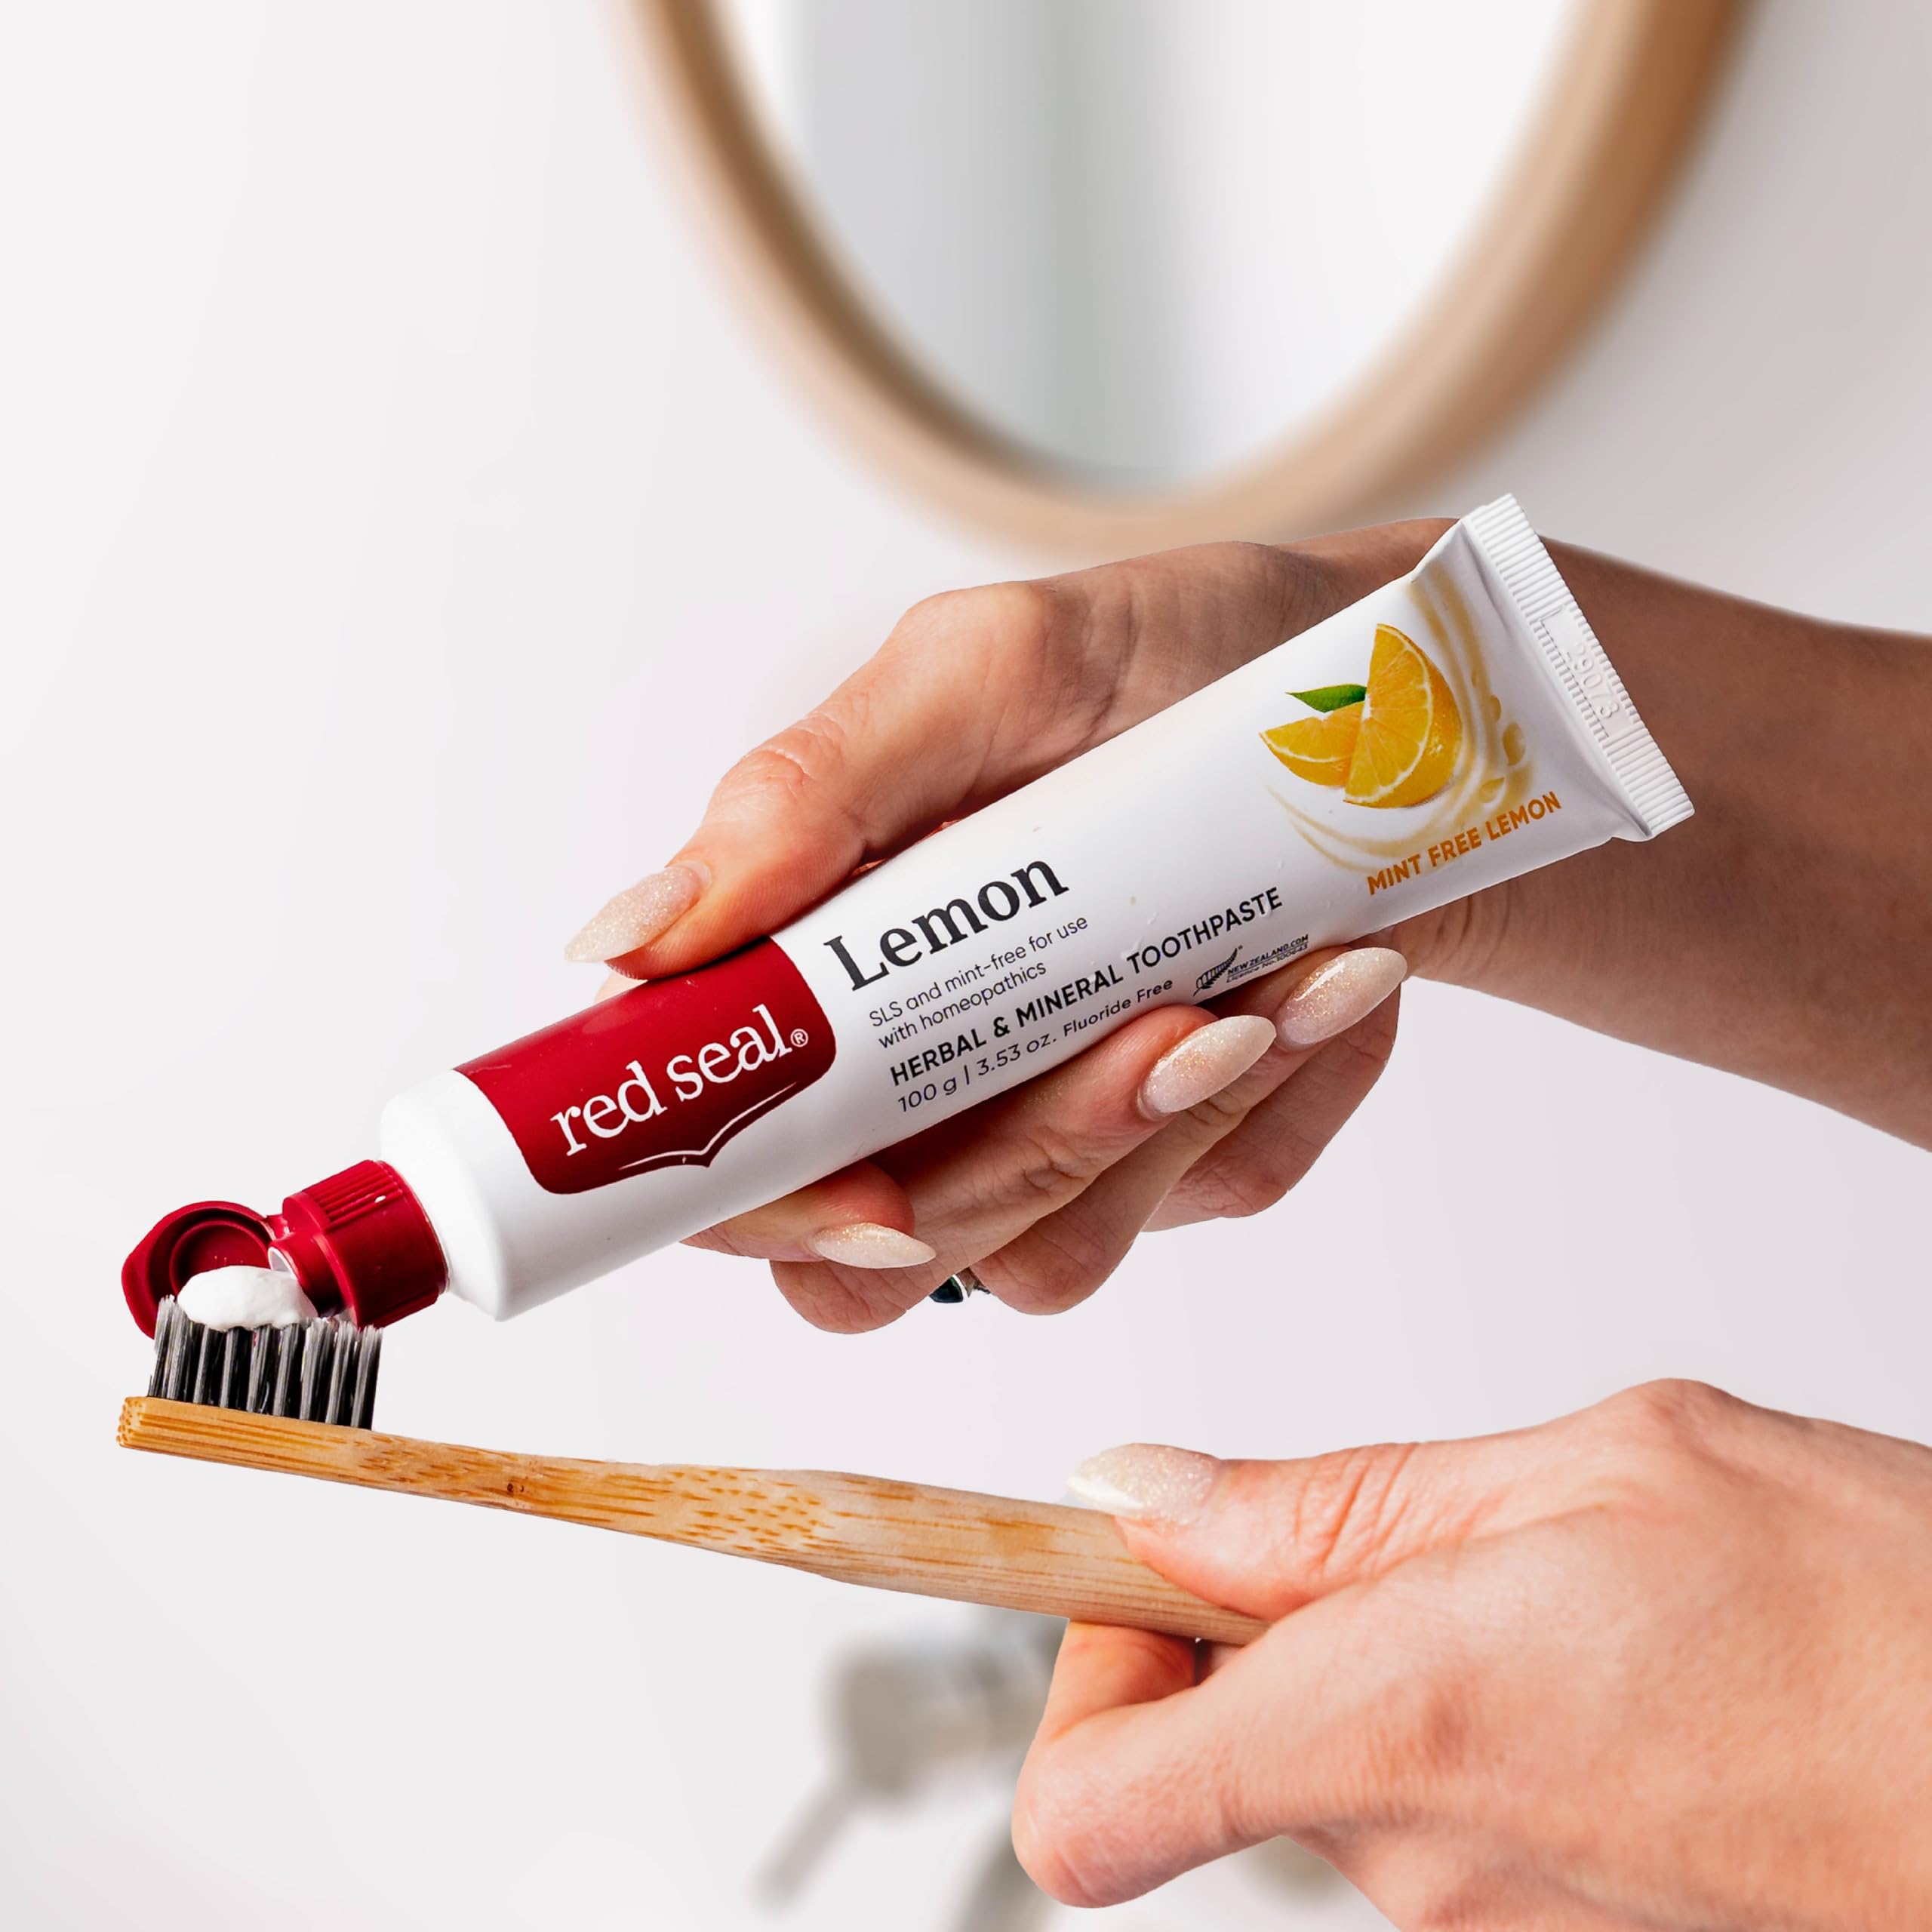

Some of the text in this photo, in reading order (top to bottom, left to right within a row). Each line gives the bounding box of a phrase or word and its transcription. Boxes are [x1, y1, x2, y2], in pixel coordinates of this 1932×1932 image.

[1367, 791, 1561, 895] MINT FREE LEMON
[823, 860, 1068, 991] Lemon
[869, 917, 1088, 1027] SLS and mint-free for use
[878, 961, 1047, 1048] with homeopathics
[890, 888, 1283, 1086] HERBAL & MINERAL TOOTHPASTE
[897, 1084, 937, 1112] 100
[943, 1077, 957, 1095] g
[977, 1044, 1020, 1075] 3.53
[1026, 1033, 1057, 1054] oz.
[1063, 998, 1131, 1037] Fluoride
[1137, 980, 1173, 1003] Free
[550, 1060, 667, 1156] red
